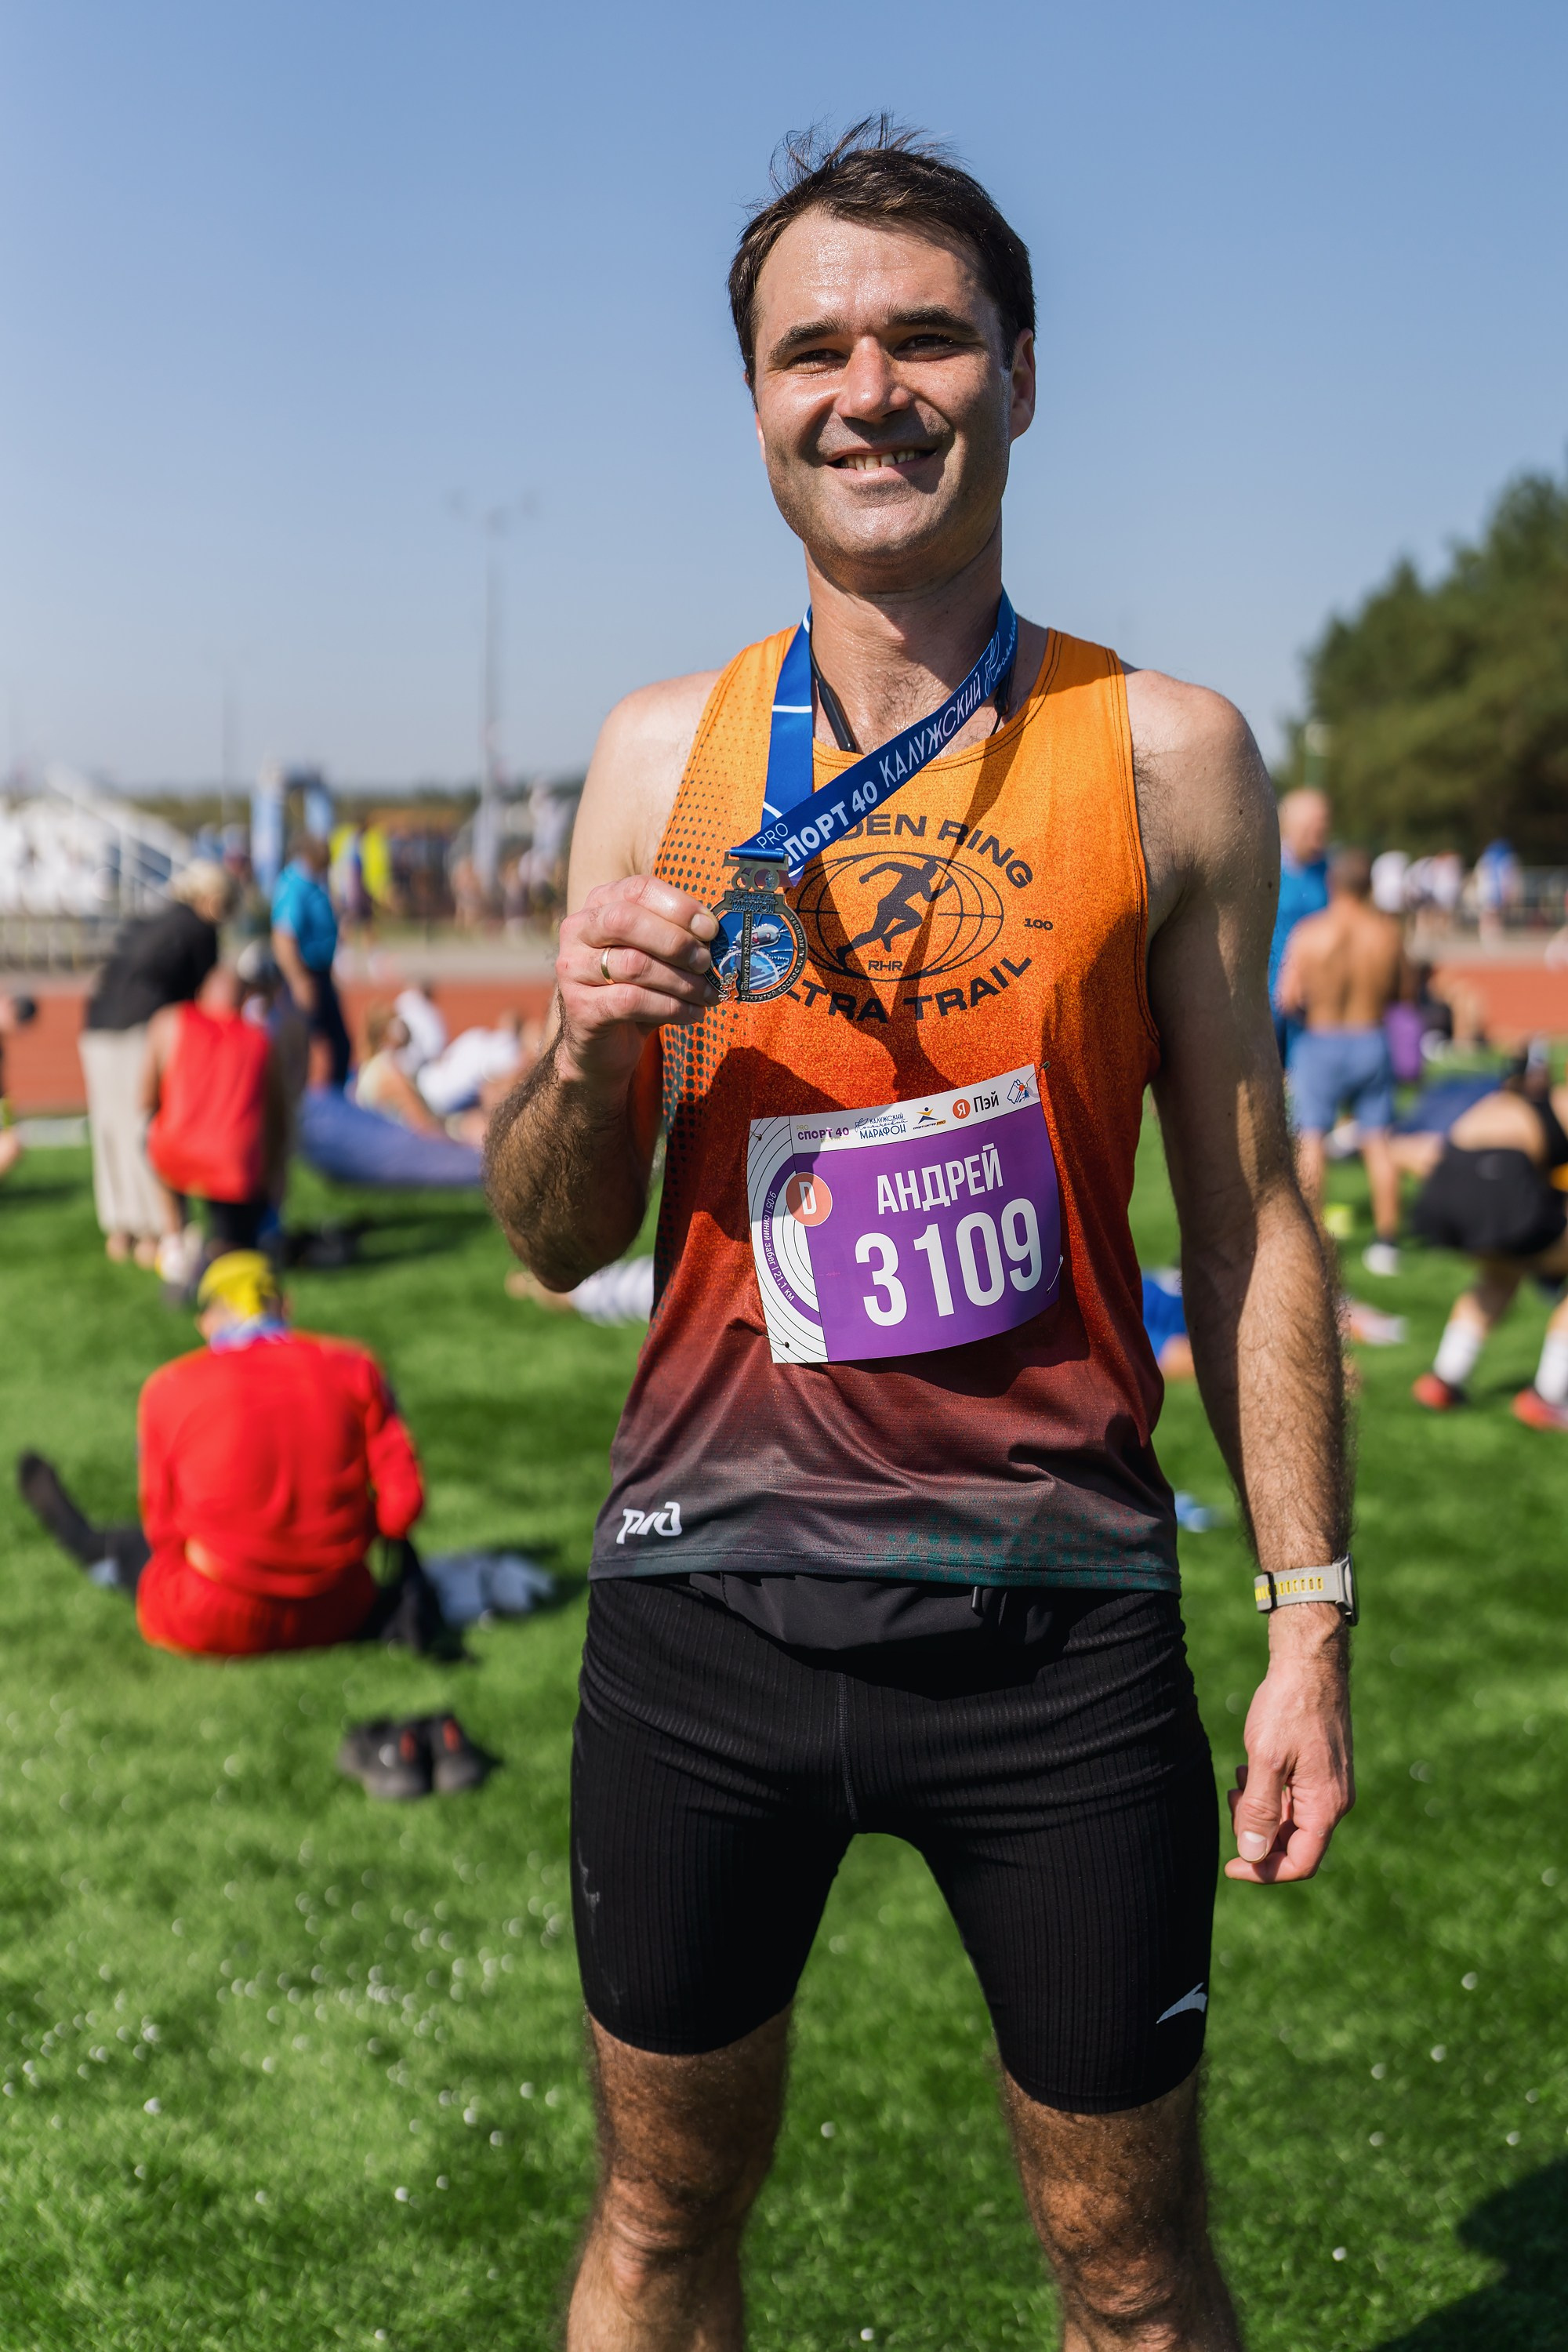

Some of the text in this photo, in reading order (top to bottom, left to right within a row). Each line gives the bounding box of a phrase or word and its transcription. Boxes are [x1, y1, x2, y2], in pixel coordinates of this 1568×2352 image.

[851, 781, 878, 812] 40
[878, 671, 982, 789] КАЛУЖСКИЙ
[756, 822, 789, 849] PRO
[937, 818, 1033, 890] RING
[1024, 918, 1054, 931] 100
[867, 960, 903, 972] RHR
[779, 967, 800, 993] КОСМОС
[903, 956, 1033, 1020] TRAIL
[972, 1091, 1000, 1113] Пэй
[869, 1112, 904, 1124] КАЛУЖСКИЙ
[797, 1127, 833, 1141] СПОРТ
[835, 1127, 850, 1137] 40
[859, 1123, 906, 1140] МАРАФОН
[877, 1142, 1004, 1215] АНДРЕЙ
[798, 1181, 818, 1215] D
[763, 1215, 771, 1241] синий
[764, 1243, 776, 1265] забег
[854, 1197, 1043, 1327] 3109
[773, 1271, 788, 1289] 21,1
